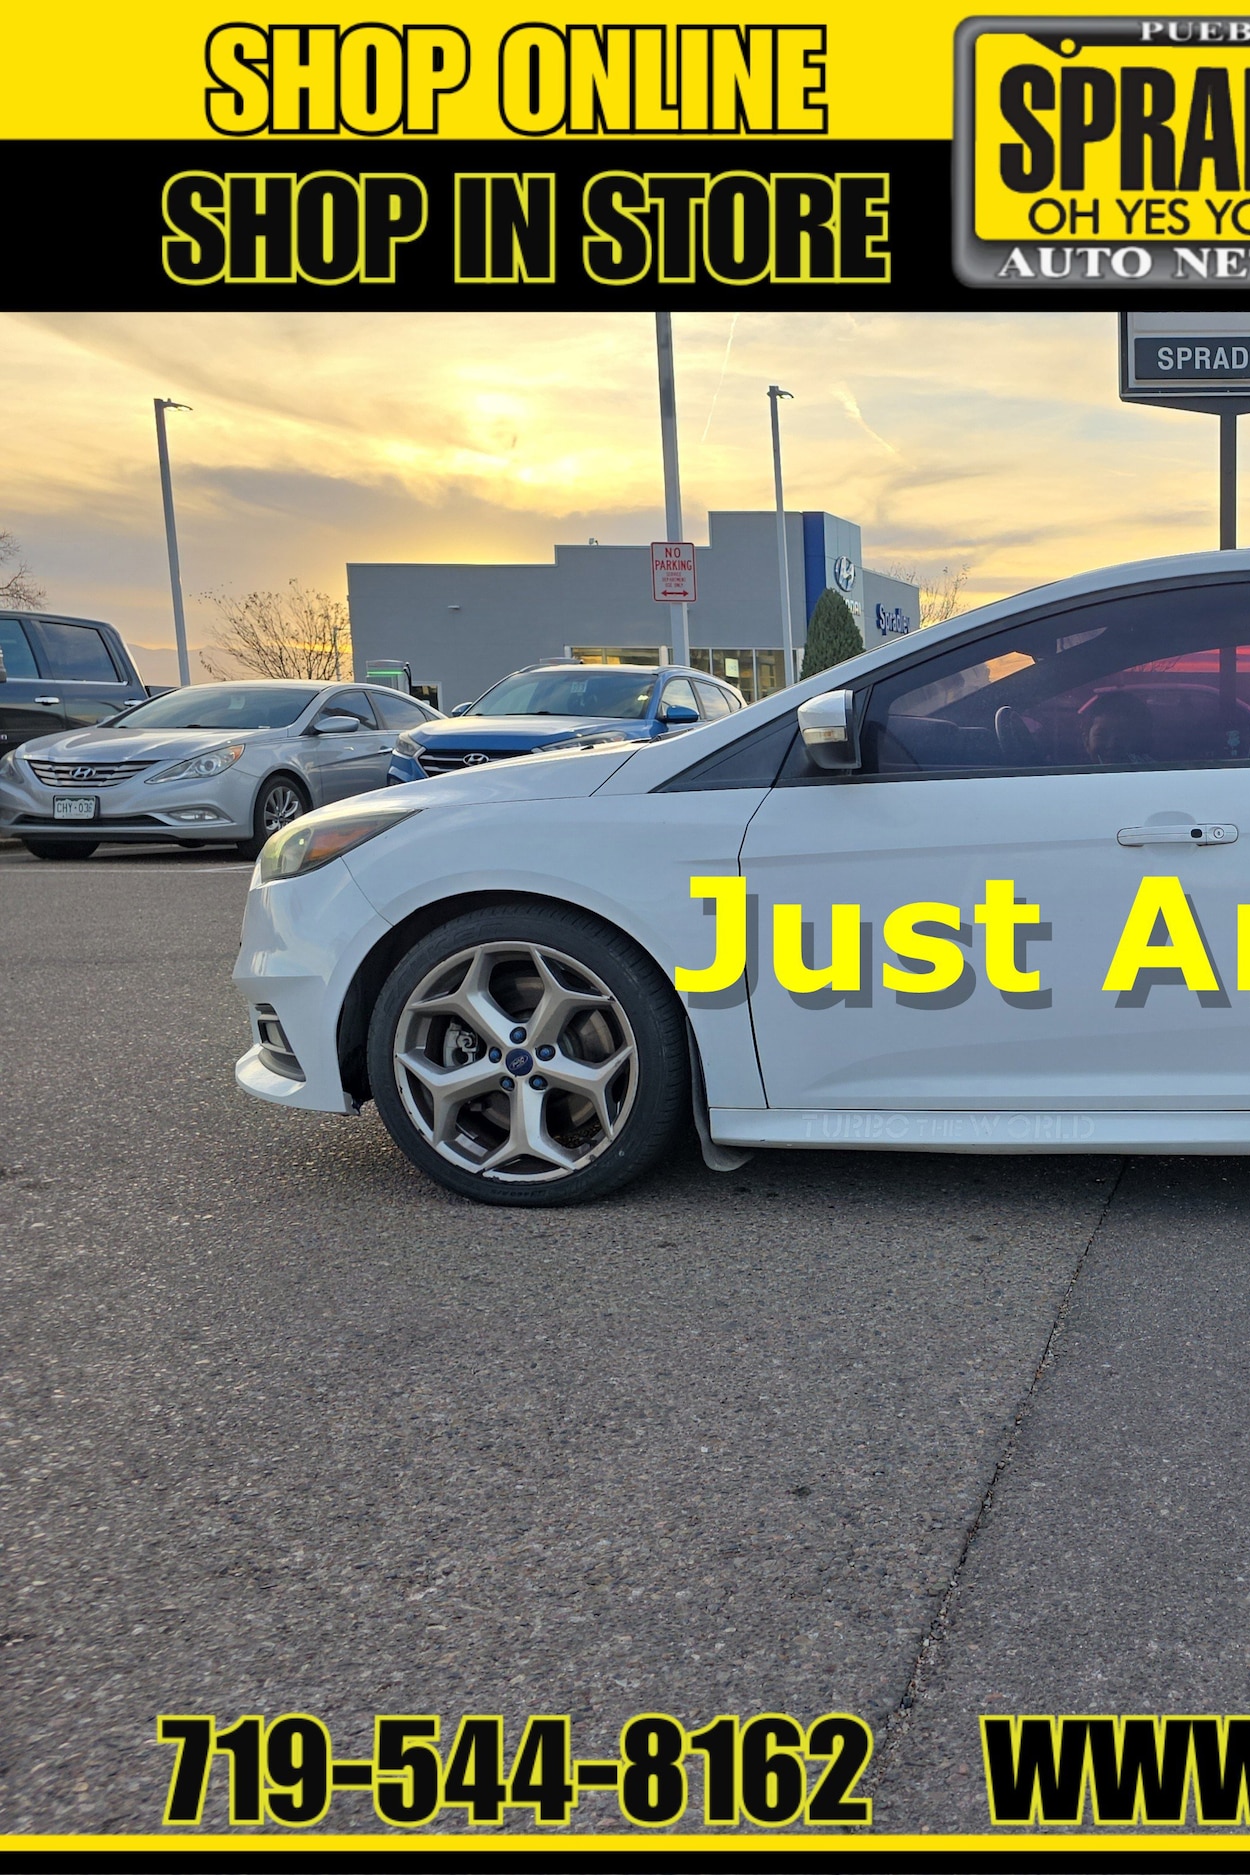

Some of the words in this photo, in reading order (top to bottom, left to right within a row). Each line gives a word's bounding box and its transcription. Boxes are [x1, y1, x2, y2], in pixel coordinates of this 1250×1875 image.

[664, 547, 681, 559] NO
[655, 559, 693, 571] PARKING
[876, 602, 911, 636] Spradley
[801, 1114, 910, 1139] TURBO
[968, 1114, 1096, 1139] WORLD
